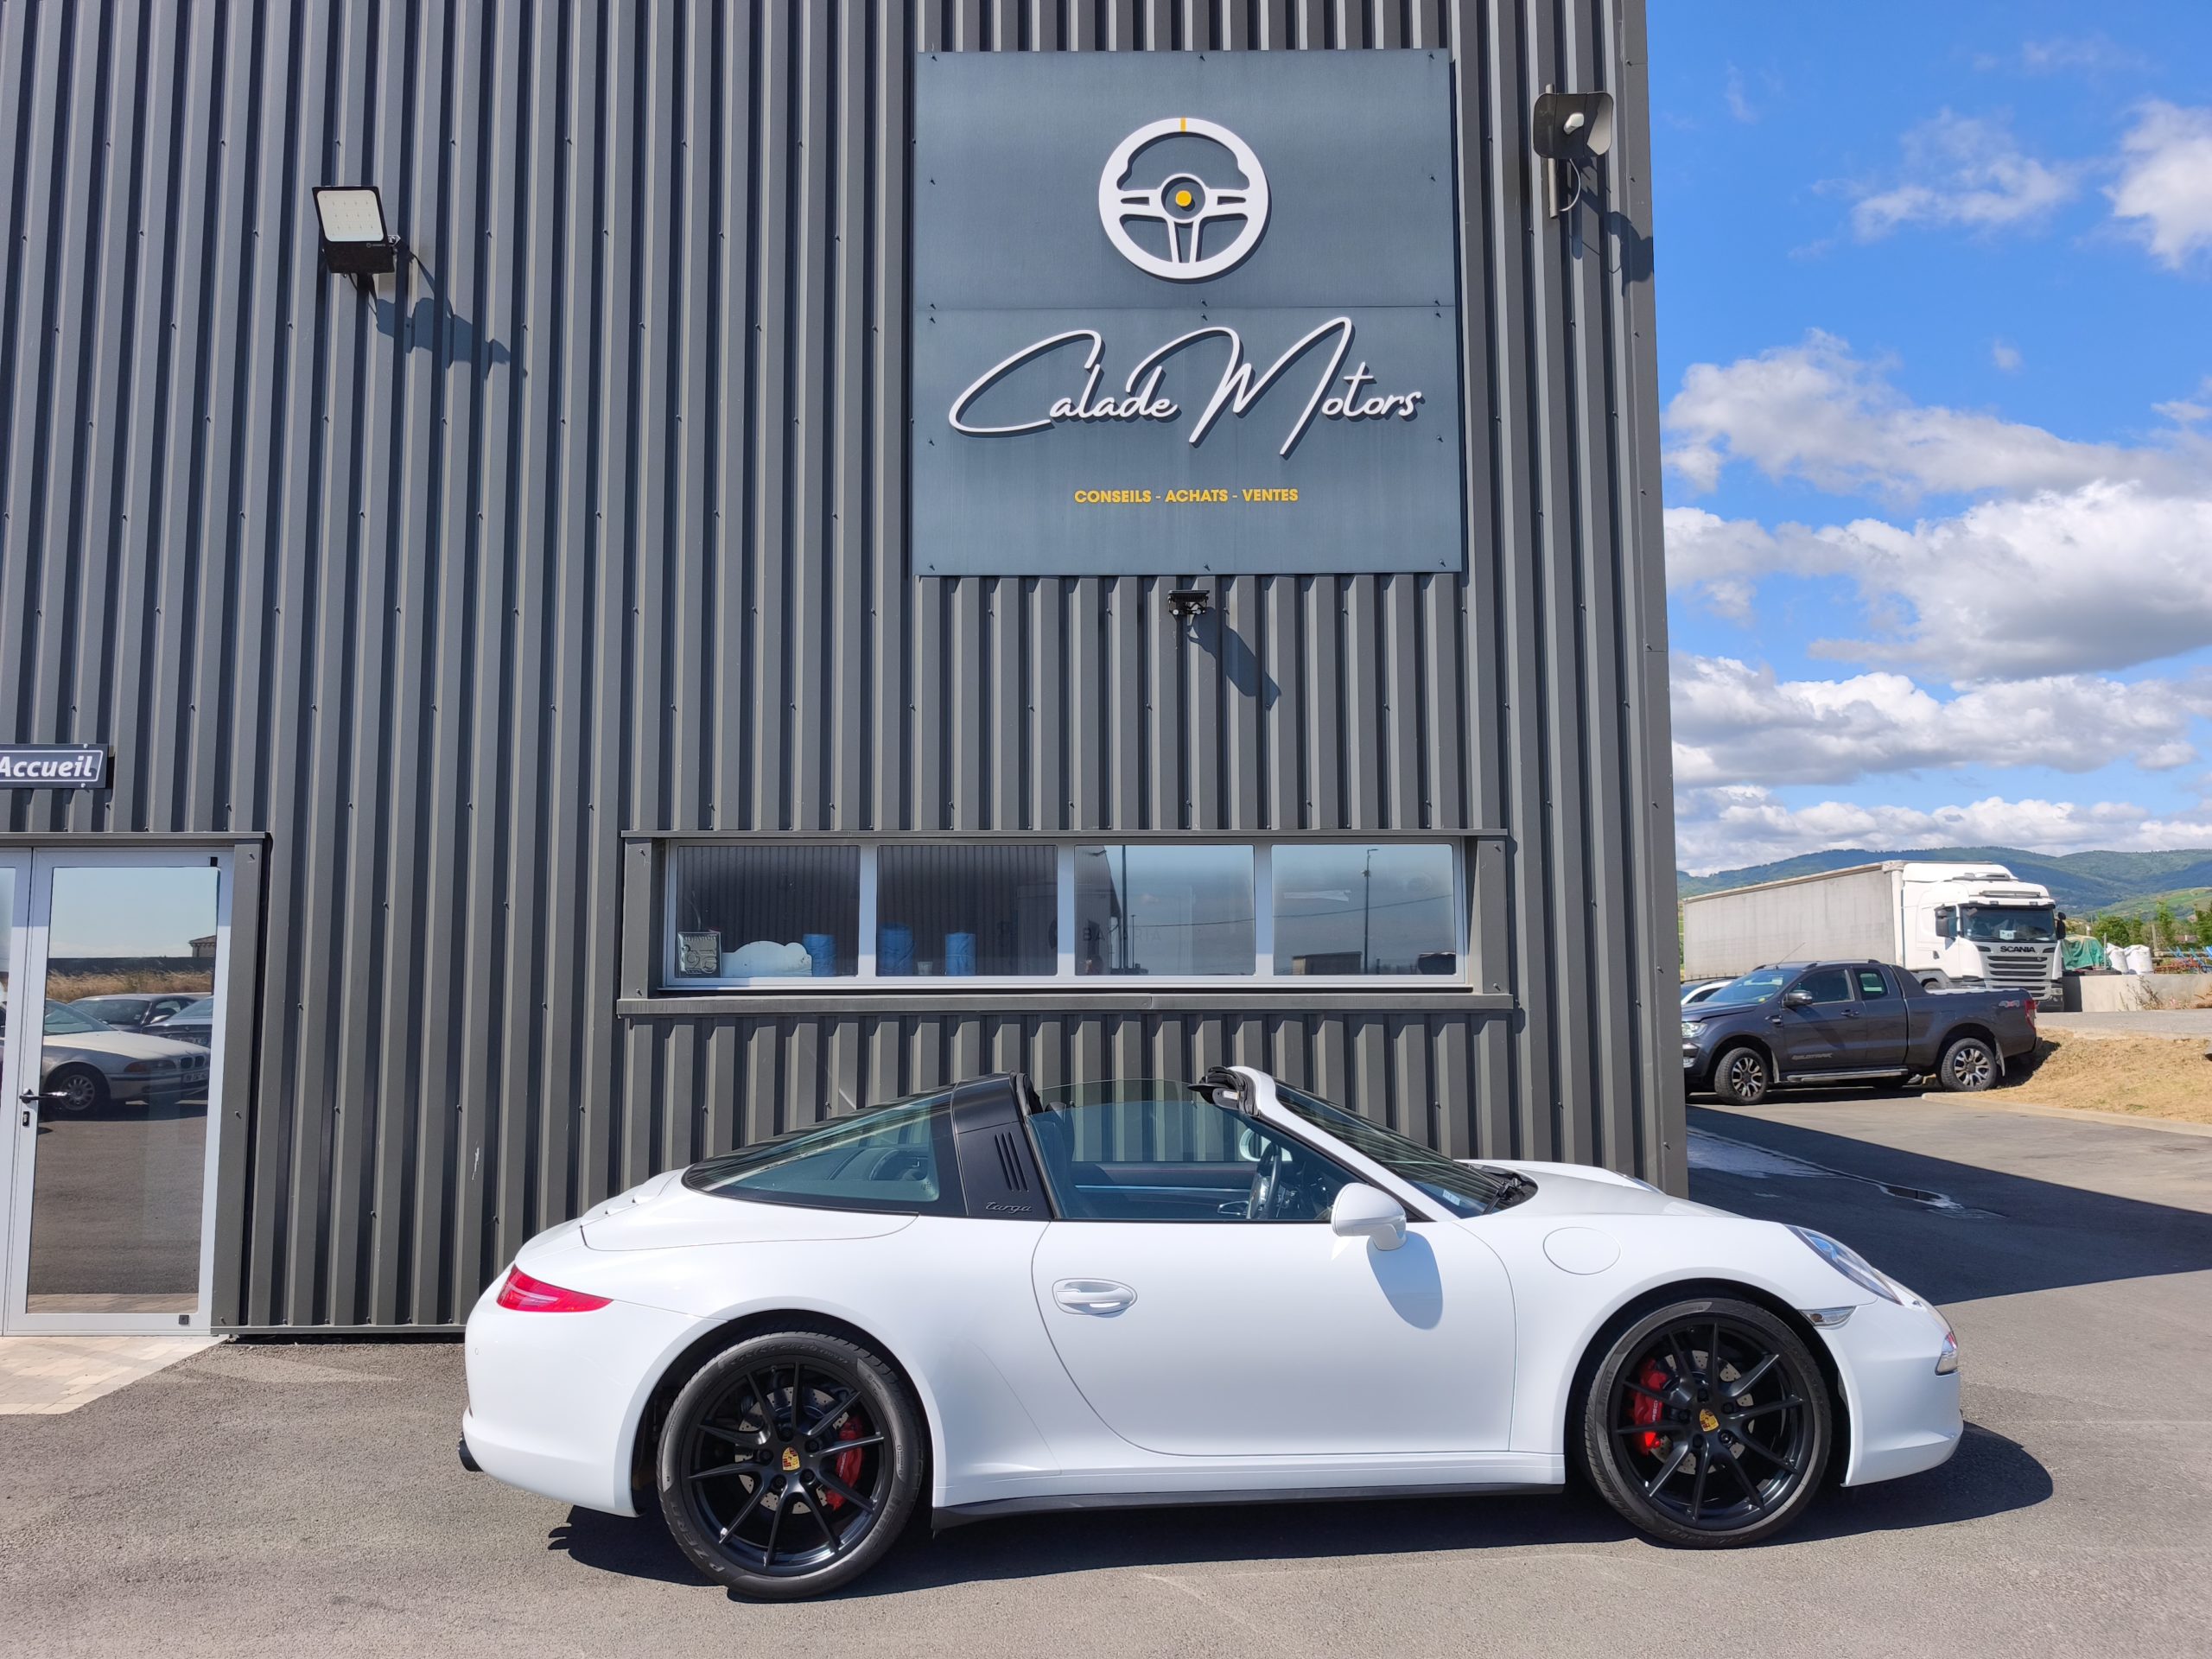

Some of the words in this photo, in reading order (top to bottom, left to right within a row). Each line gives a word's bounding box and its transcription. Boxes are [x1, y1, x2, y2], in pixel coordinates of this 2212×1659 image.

[949, 329, 1179, 434] Calade
[1125, 316, 1423, 455] Motors
[1074, 490, 1152, 503] CONSEILS
[1165, 489, 1228, 502] ACHATS
[1242, 488, 1299, 501] VENTES
[0, 755, 93, 778] Accueil
